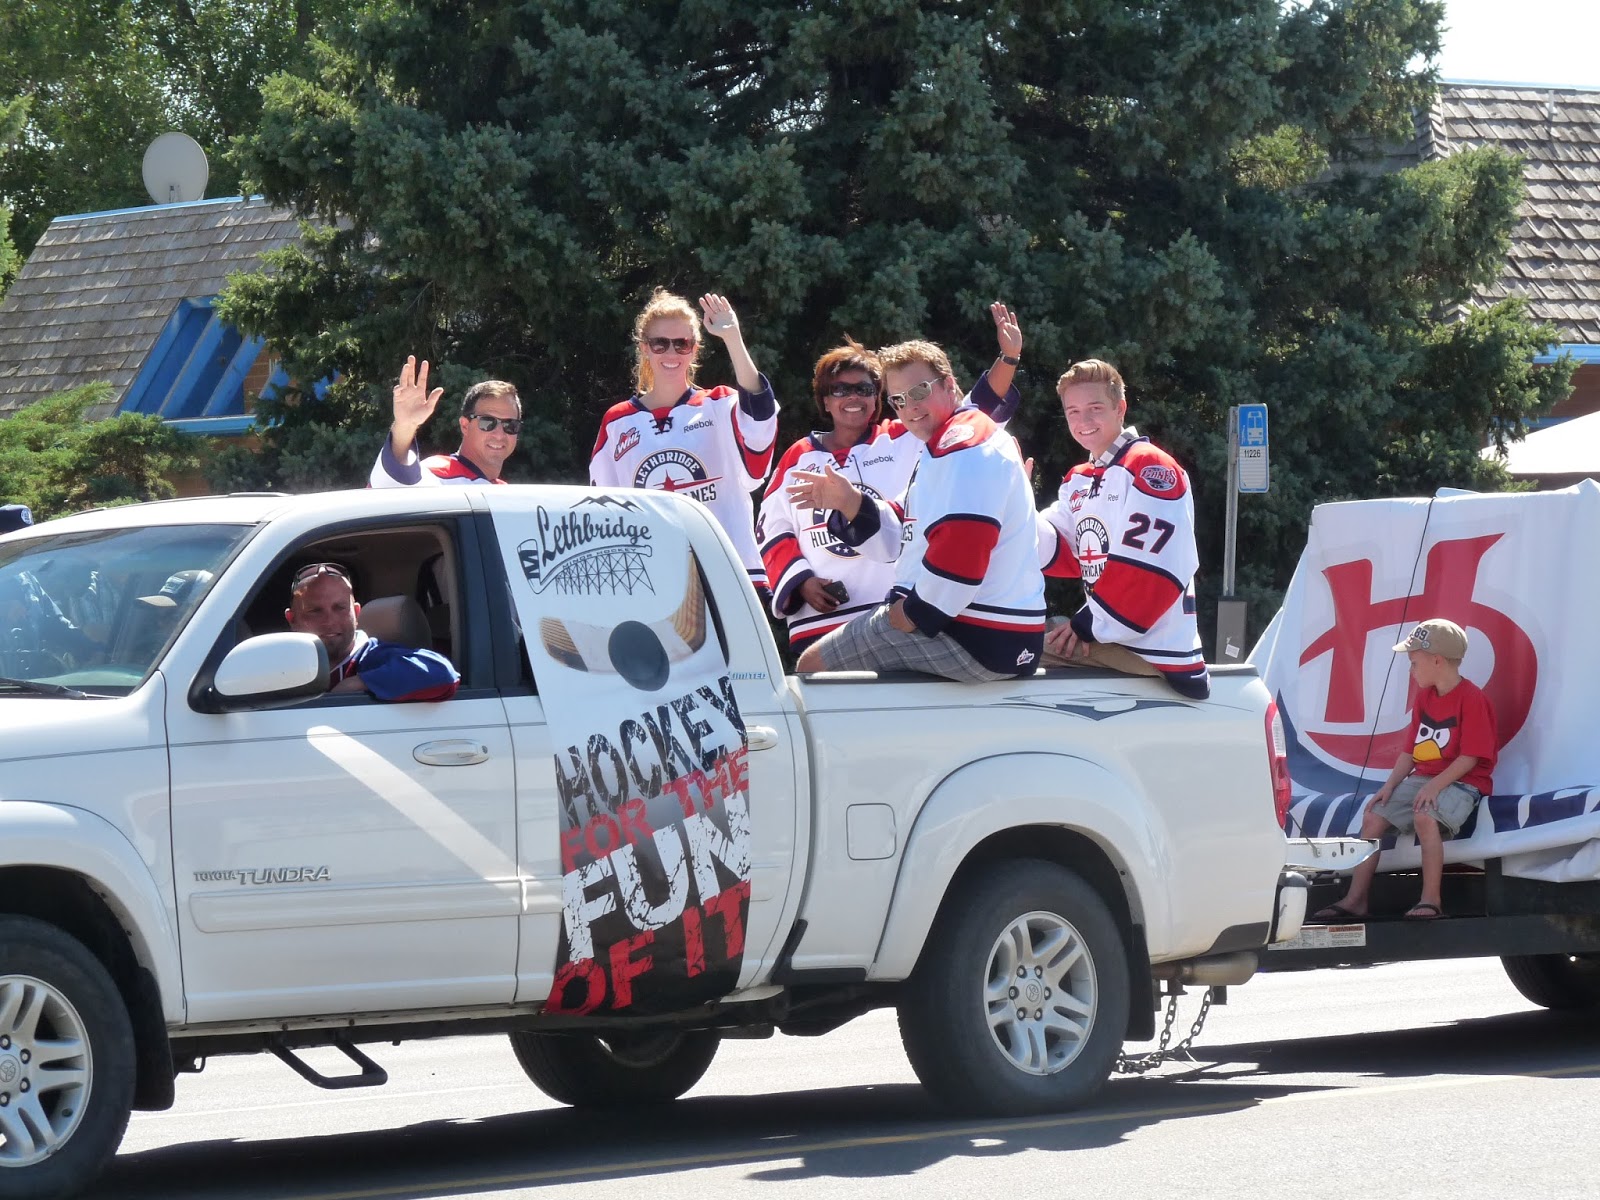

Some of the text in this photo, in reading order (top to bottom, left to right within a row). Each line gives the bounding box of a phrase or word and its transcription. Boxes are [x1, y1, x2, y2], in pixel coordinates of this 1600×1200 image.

[683, 419, 714, 433] Reebok
[635, 451, 700, 485] LETHBRIDGE
[862, 455, 895, 468] Reebok
[1244, 449, 1261, 458] 11226
[537, 505, 652, 567] Lethbridge
[1122, 512, 1175, 554] 27
[562, 547, 637, 569] MINOR HOCKEY
[1414, 627, 1428, 641] 89
[554, 675, 749, 829] HOCKEY
[560, 746, 749, 876] FOR THE
[193, 865, 331, 885] TOYOTA TUNDRA
[562, 790, 751, 965] FUN
[541, 878, 751, 1015] OF IT
